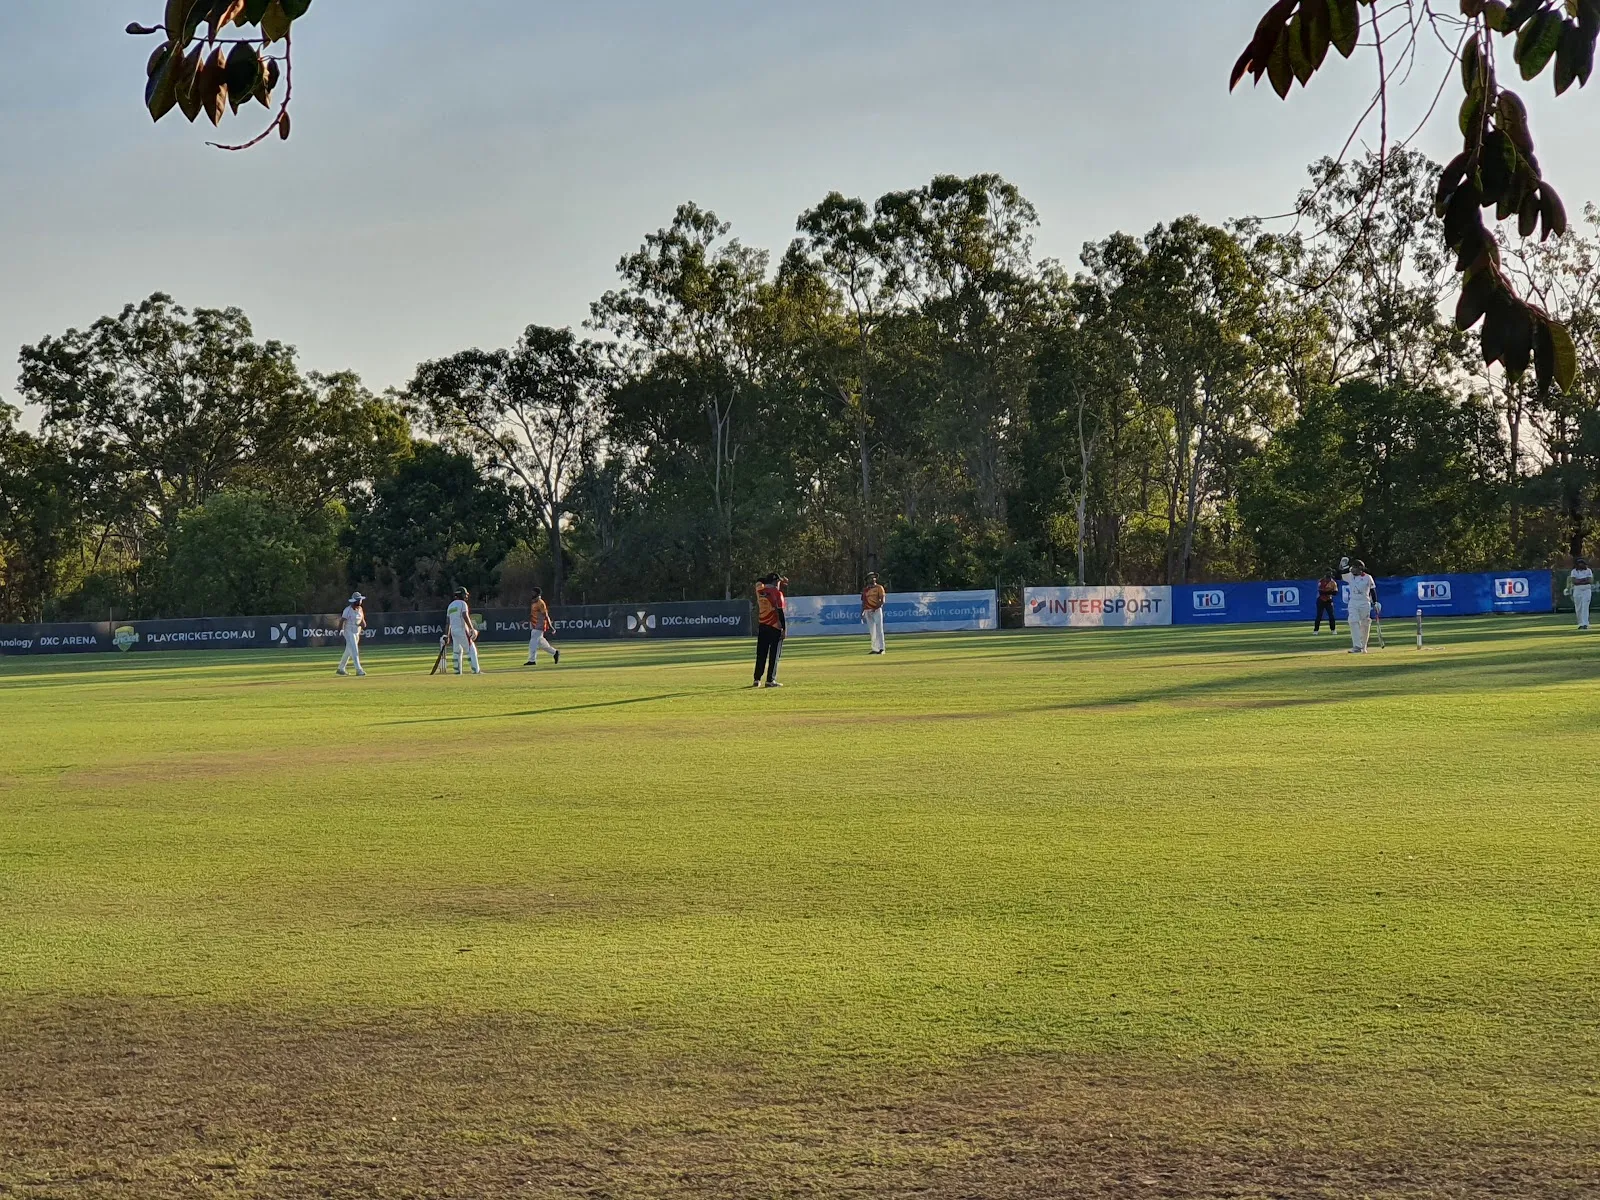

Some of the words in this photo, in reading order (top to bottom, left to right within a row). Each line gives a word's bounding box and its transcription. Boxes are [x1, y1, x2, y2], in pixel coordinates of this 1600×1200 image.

[1421, 584, 1447, 598] TiO
[1499, 581, 1525, 595] TiO
[1196, 593, 1221, 607] TiO
[1271, 590, 1296, 604] TiO
[1049, 598, 1163, 614] INTERSPORT
[495, 619, 612, 631] PLAYCET.COM.AU
[661, 615, 741, 626] DXC.technology
[147, 630, 256, 643] PLAYCRICKET.COM.AU
[302, 628, 377, 638] DXC.tecogy
[384, 626, 405, 635] DXC
[407, 625, 443, 635] ARENA
[40, 637, 60, 646] DXC
[62, 636, 97, 645] ARENA
